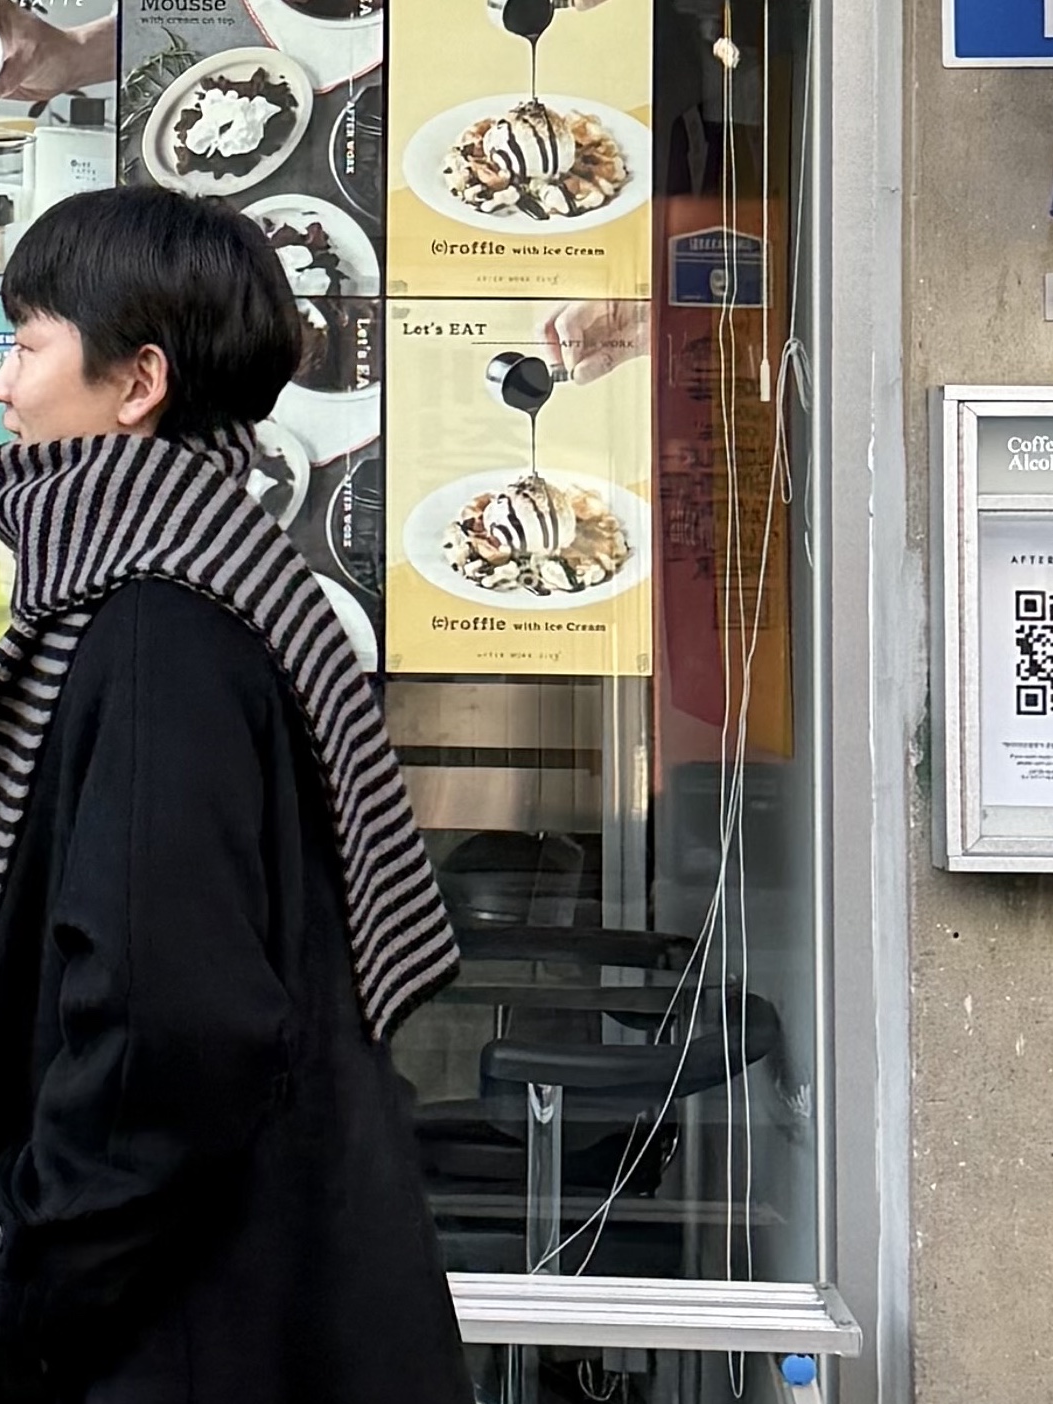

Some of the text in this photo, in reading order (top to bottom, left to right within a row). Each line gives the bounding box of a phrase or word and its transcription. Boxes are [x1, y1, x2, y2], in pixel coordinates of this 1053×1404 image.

[141, 0, 227, 11] Mousse
[431, 240, 605, 255] (c)roffle with Ice Cream
[403, 322, 487, 335] Let's EAT
[357, 365, 370, 389] EA
[513, 622, 541, 631] with
[545, 622, 562, 631] Ice
[566, 622, 606, 631] Cream
